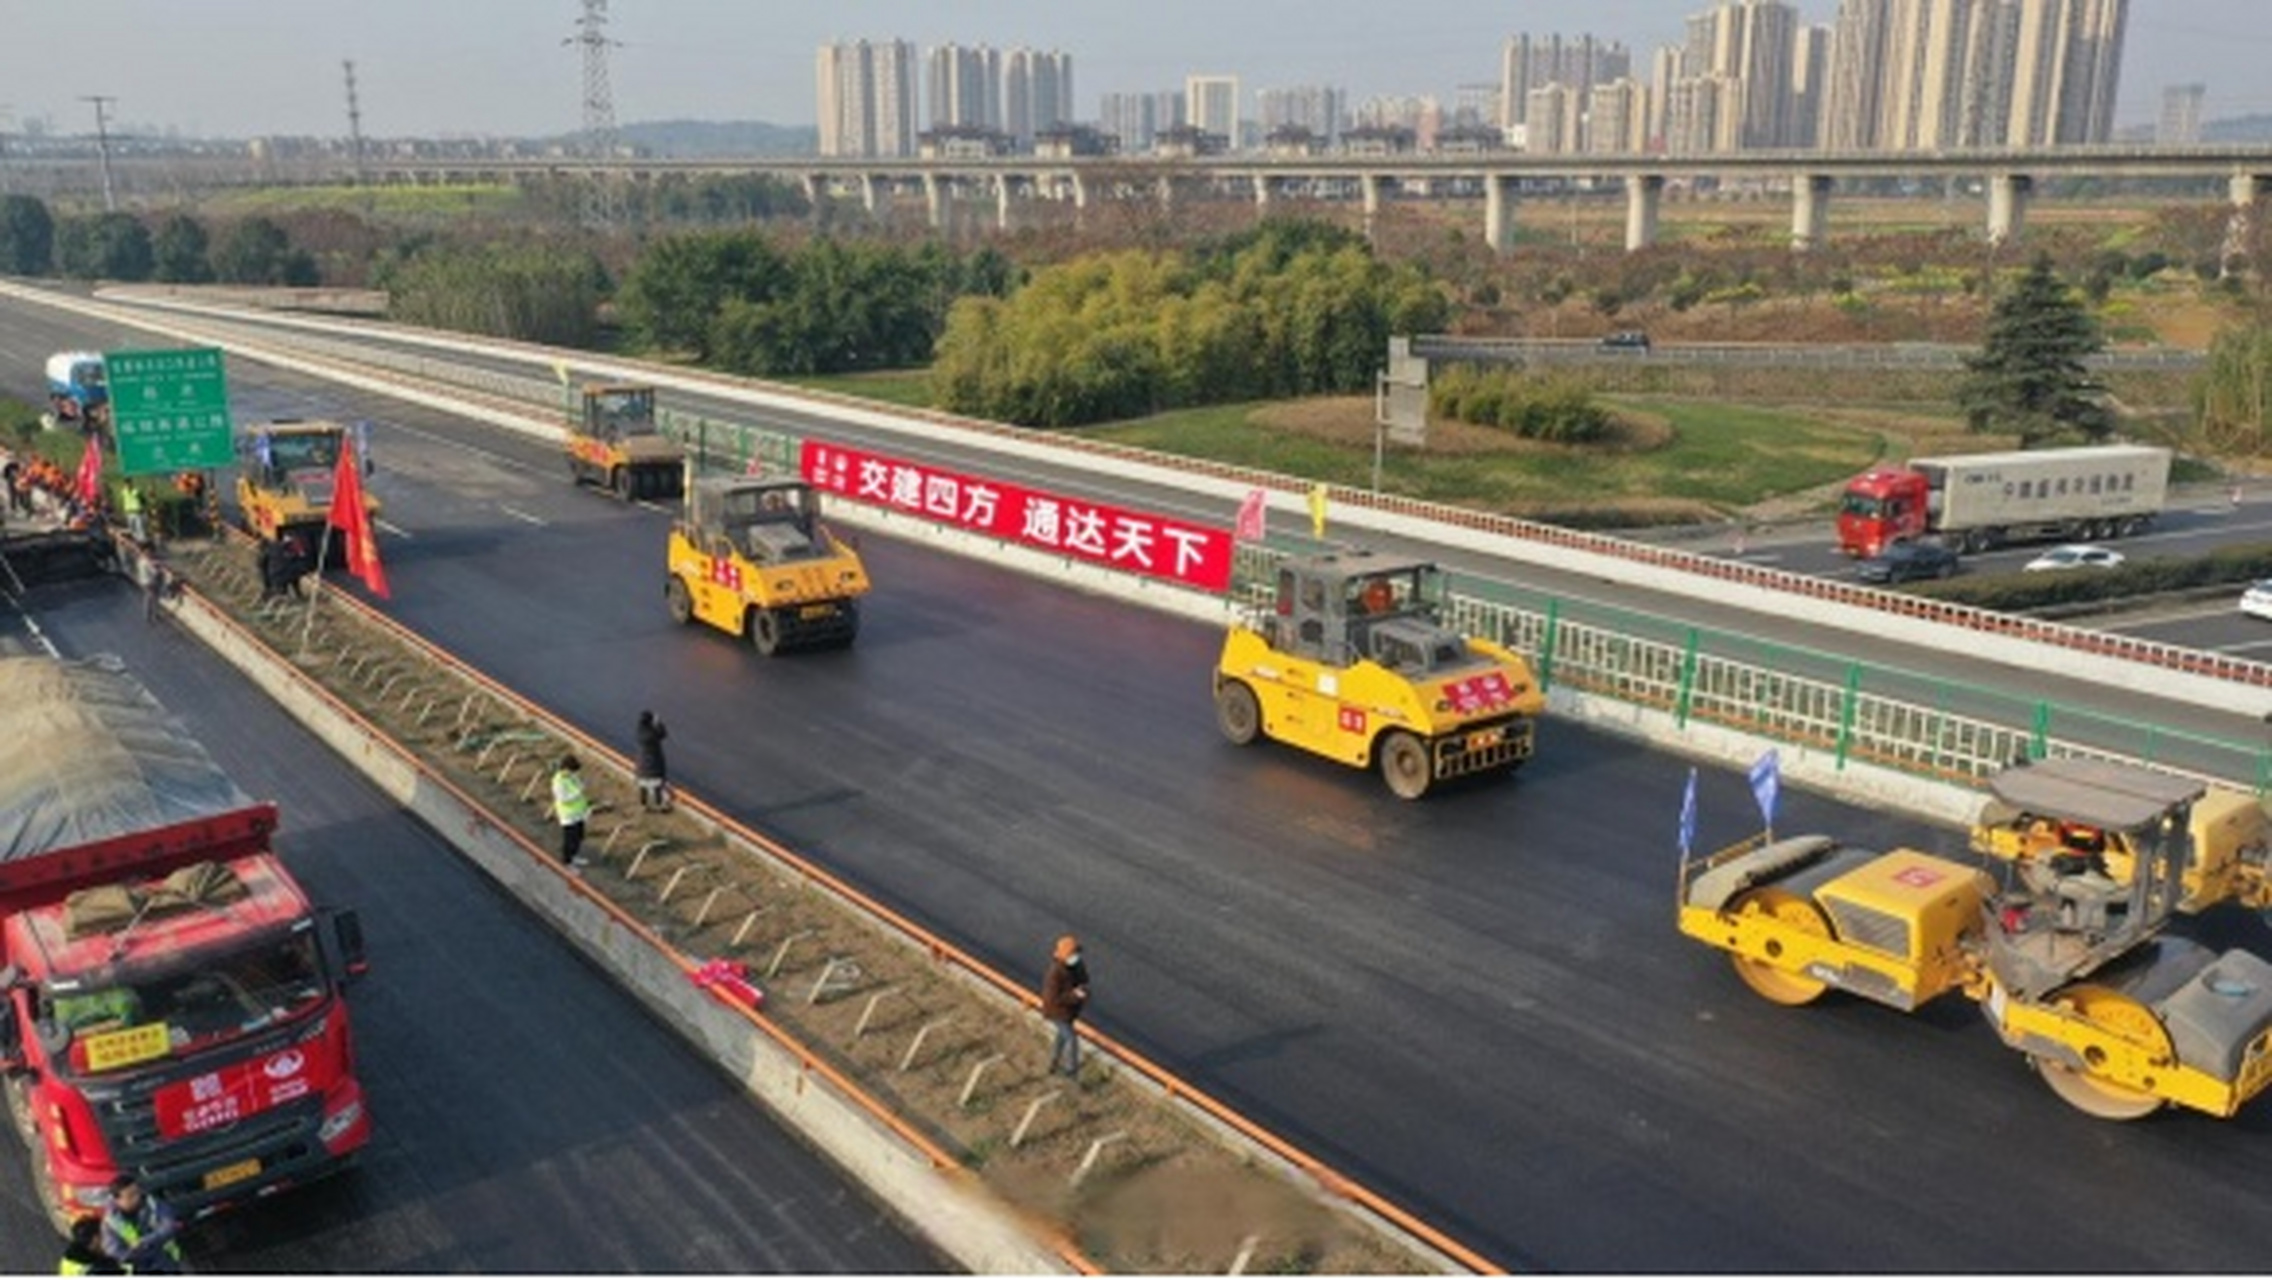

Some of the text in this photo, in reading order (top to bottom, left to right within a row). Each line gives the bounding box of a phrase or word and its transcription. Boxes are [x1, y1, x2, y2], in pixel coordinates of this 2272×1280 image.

[858, 460, 999, 526] 交建四方
[1021, 496, 1208, 575] 通达天下
